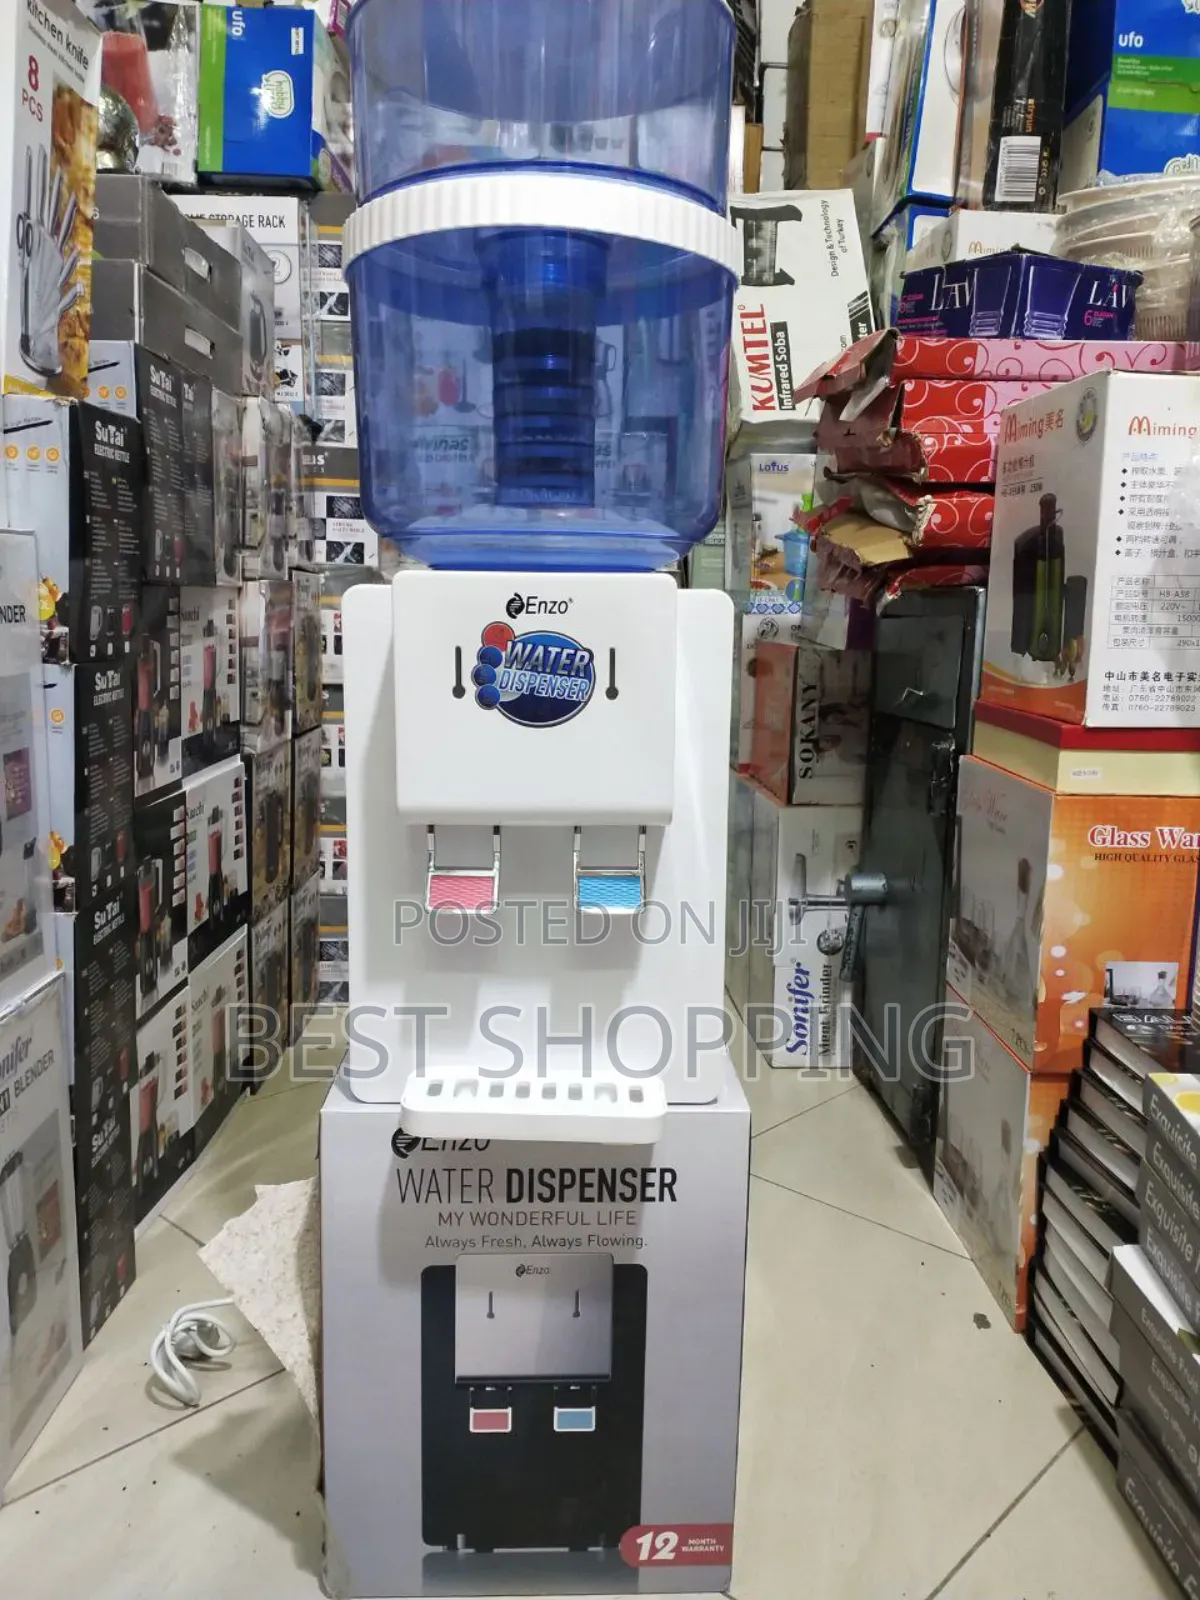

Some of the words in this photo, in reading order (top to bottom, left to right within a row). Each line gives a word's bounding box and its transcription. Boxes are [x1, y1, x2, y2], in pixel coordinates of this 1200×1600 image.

[232, 10, 245, 37] ufo
[66, 33, 89, 71] knife
[1118, 31, 1144, 49] ufo
[28, 54, 39, 92] 8
[22, 87, 43, 122] PCS
[258, 214, 286, 229] RACK
[820, 199, 834, 243] Technology
[836, 219, 847, 244] Turkey
[826, 250, 839, 278] Design
[1084, 310, 1094, 326] 6
[740, 303, 777, 412] KUMTEL
[773, 331, 789, 355] Soba
[776, 356, 796, 411] Infrared
[95, 420, 125, 447] SuTai
[1128, 416, 1198, 440] Miming
[525, 595, 569, 615] Enzo
[503, 640, 592, 678] WATER
[94, 669, 121, 692] SuTai
[498, 668, 590, 702] DISPENSER
[1104, 670, 1200, 682] 中山市美名电子实
[798, 680, 818, 779] SOKANY
[1087, 825, 1152, 849] Glass
[1094, 853, 1124, 862] HIGH
[1124, 854, 1170, 864] QUALITY
[94, 895, 120, 931] SuTai
[784, 961, 815, 1056] Sonifer
[14, 1049, 55, 1099] BLENDER
[1150, 1092, 1198, 1172] Exquisite
[396, 1168, 495, 1205] WATER
[506, 1167, 679, 1203] DISPENSER
[1151, 1141, 1200, 1222] Exquisite
[438, 1211, 463, 1227] MY
[470, 1210, 591, 1227] WONDERFUL
[597, 1210, 637, 1226] LIFE
[1145, 1178, 1194, 1263] Exquisite
[425, 1235, 477, 1252] Always
[482, 1235, 527, 1251] Fresh,
[532, 1234, 583, 1250] Always
[588, 1233, 648, 1250] Flowing.
[526, 1264, 550, 1276] Enzo
[1146, 1226, 1193, 1317] Exquisite
[1124, 1475, 1180, 1578] Exquisite
[635, 1530, 679, 1561] 12
